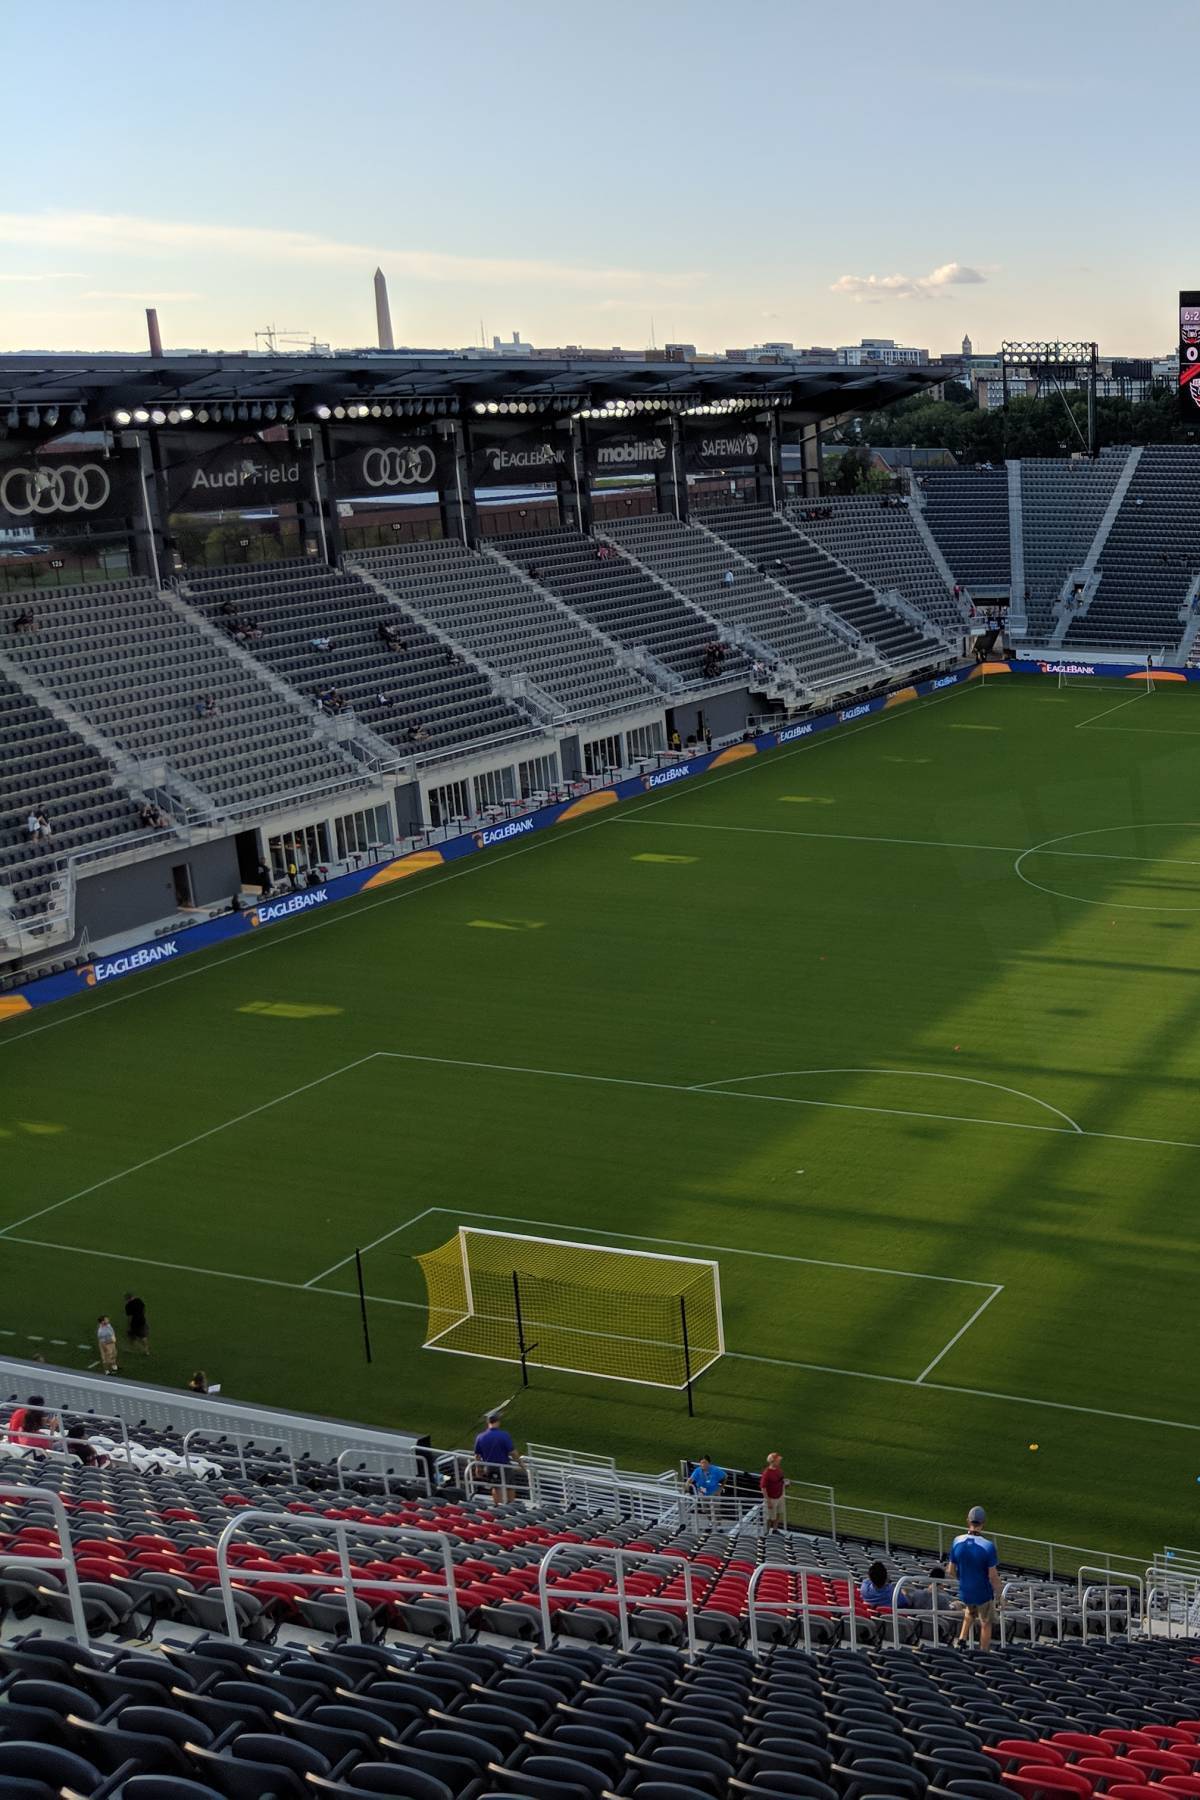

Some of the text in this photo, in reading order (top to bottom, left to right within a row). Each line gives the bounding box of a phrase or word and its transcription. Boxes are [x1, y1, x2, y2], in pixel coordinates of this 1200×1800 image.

[1187, 347, 1198, 361] 0
[701, 438, 747, 456] SAFEWAY
[1047, 663, 1095, 674] EAGLEBANK
[841, 704, 870, 722] EAGLEBANK
[780, 724, 812, 741] EAGLEBANK
[650, 766, 689, 788] EAGLEBANK
[483, 818, 534, 845] EAGLEBANK
[258, 889, 328, 922] EAGLEBANK
[95, 941, 178, 980] EAGLEBANK
